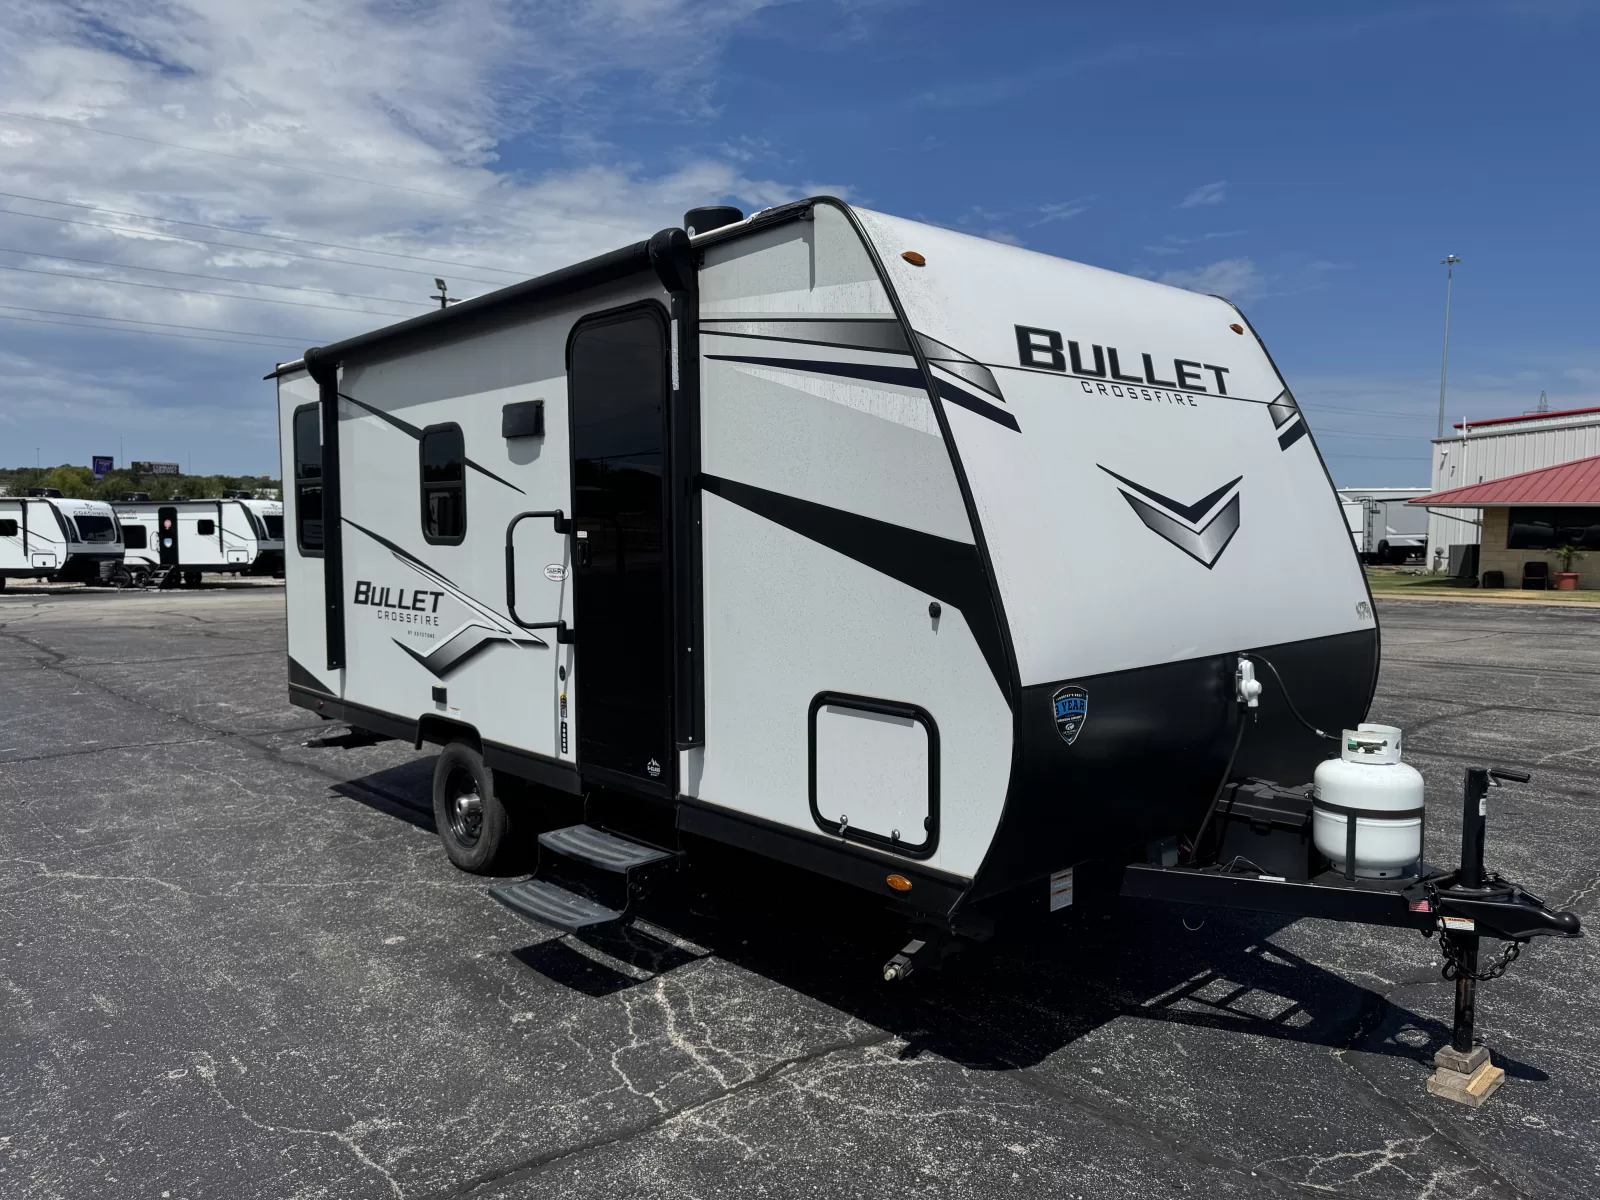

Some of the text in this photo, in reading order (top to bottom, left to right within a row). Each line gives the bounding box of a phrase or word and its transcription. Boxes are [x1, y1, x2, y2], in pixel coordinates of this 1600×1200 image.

[1014, 324, 1230, 395] BULLET
[1081, 381, 1198, 407] CROSSFIRE
[354, 580, 445, 613] BULLET
[377, 610, 439, 626] CROSSFIRE
[414, 631, 435, 639] KEYSTONE
[1061, 699, 1085, 713] YEAR
